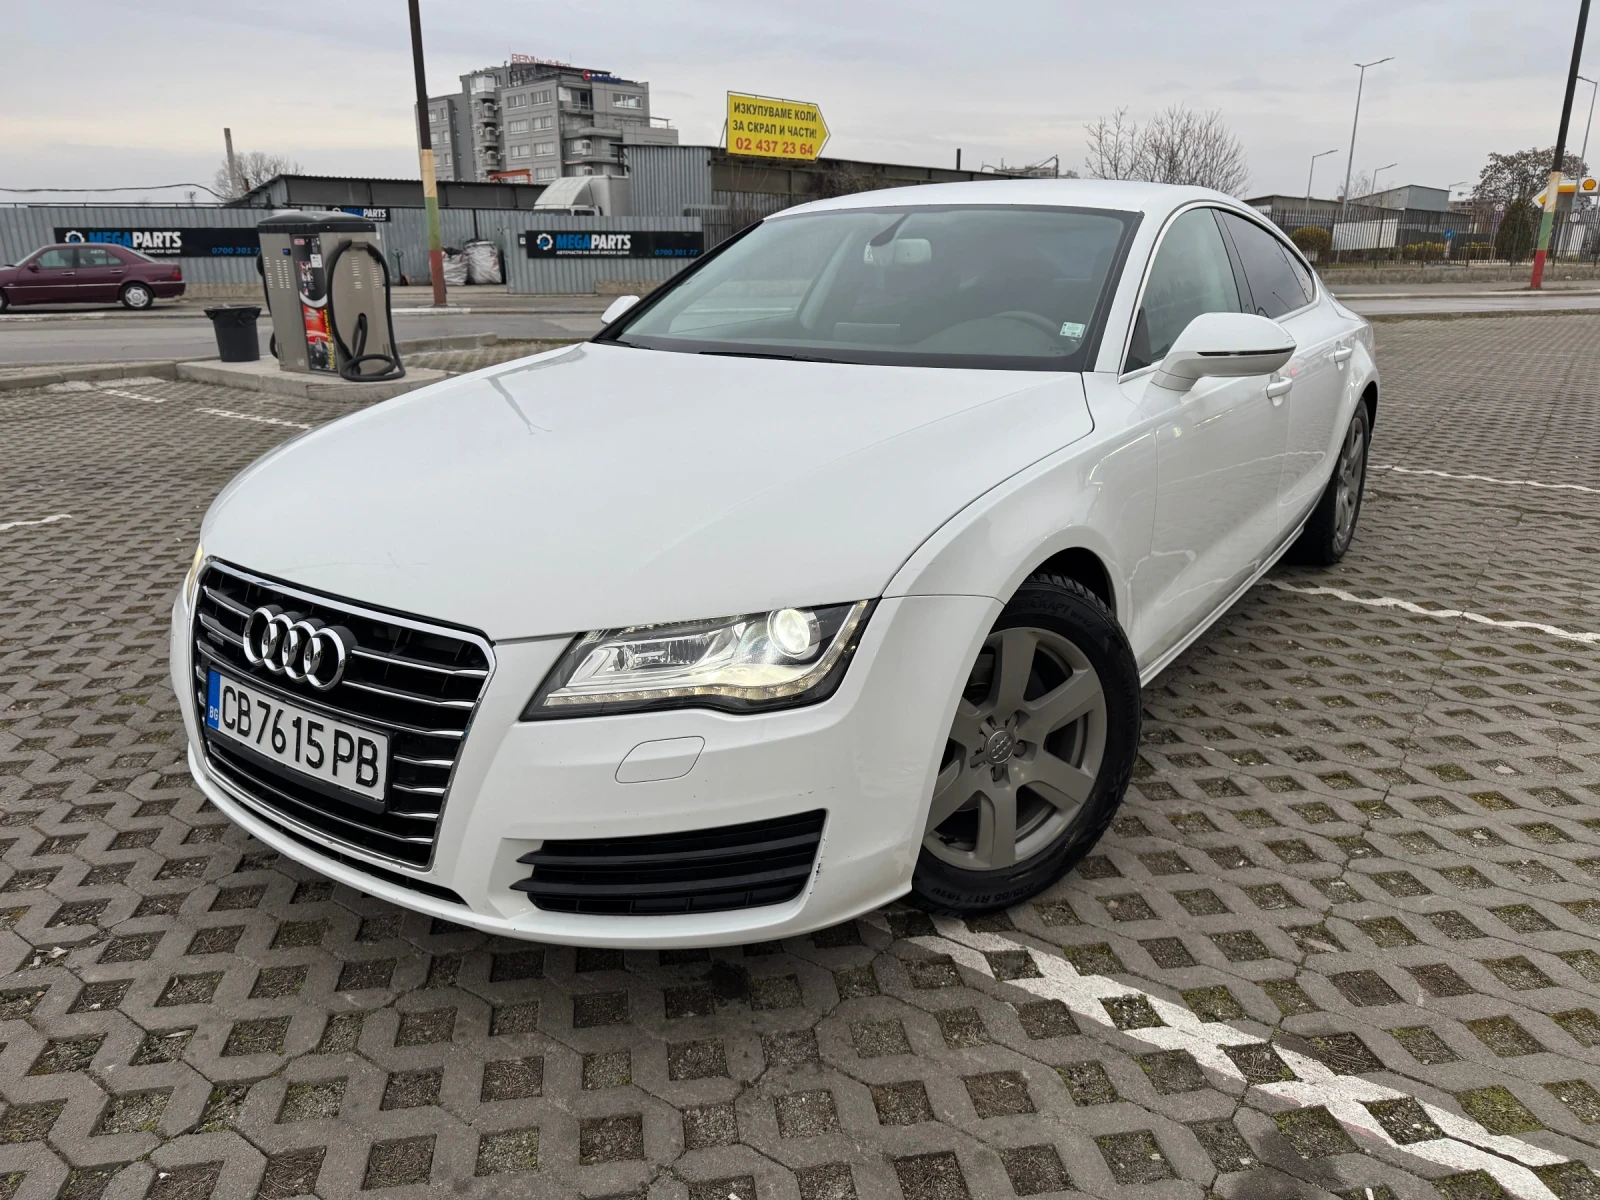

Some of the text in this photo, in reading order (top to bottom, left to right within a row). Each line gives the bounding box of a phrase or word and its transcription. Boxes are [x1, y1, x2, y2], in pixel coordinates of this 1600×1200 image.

[733, 101, 817, 122] ИЗКУПУВАМЕ КОЛИ
[732, 119, 817, 139] ЗА СКРАП И ЧАСТИ!
[735, 137, 814, 156] 02 437 23 64
[556, 234, 631, 249] MEGAPARTS
[211, 246, 260, 255] 0700 301 7
[655, 248, 698, 256] 0700 301 77
[209, 705, 219, 721] BG
